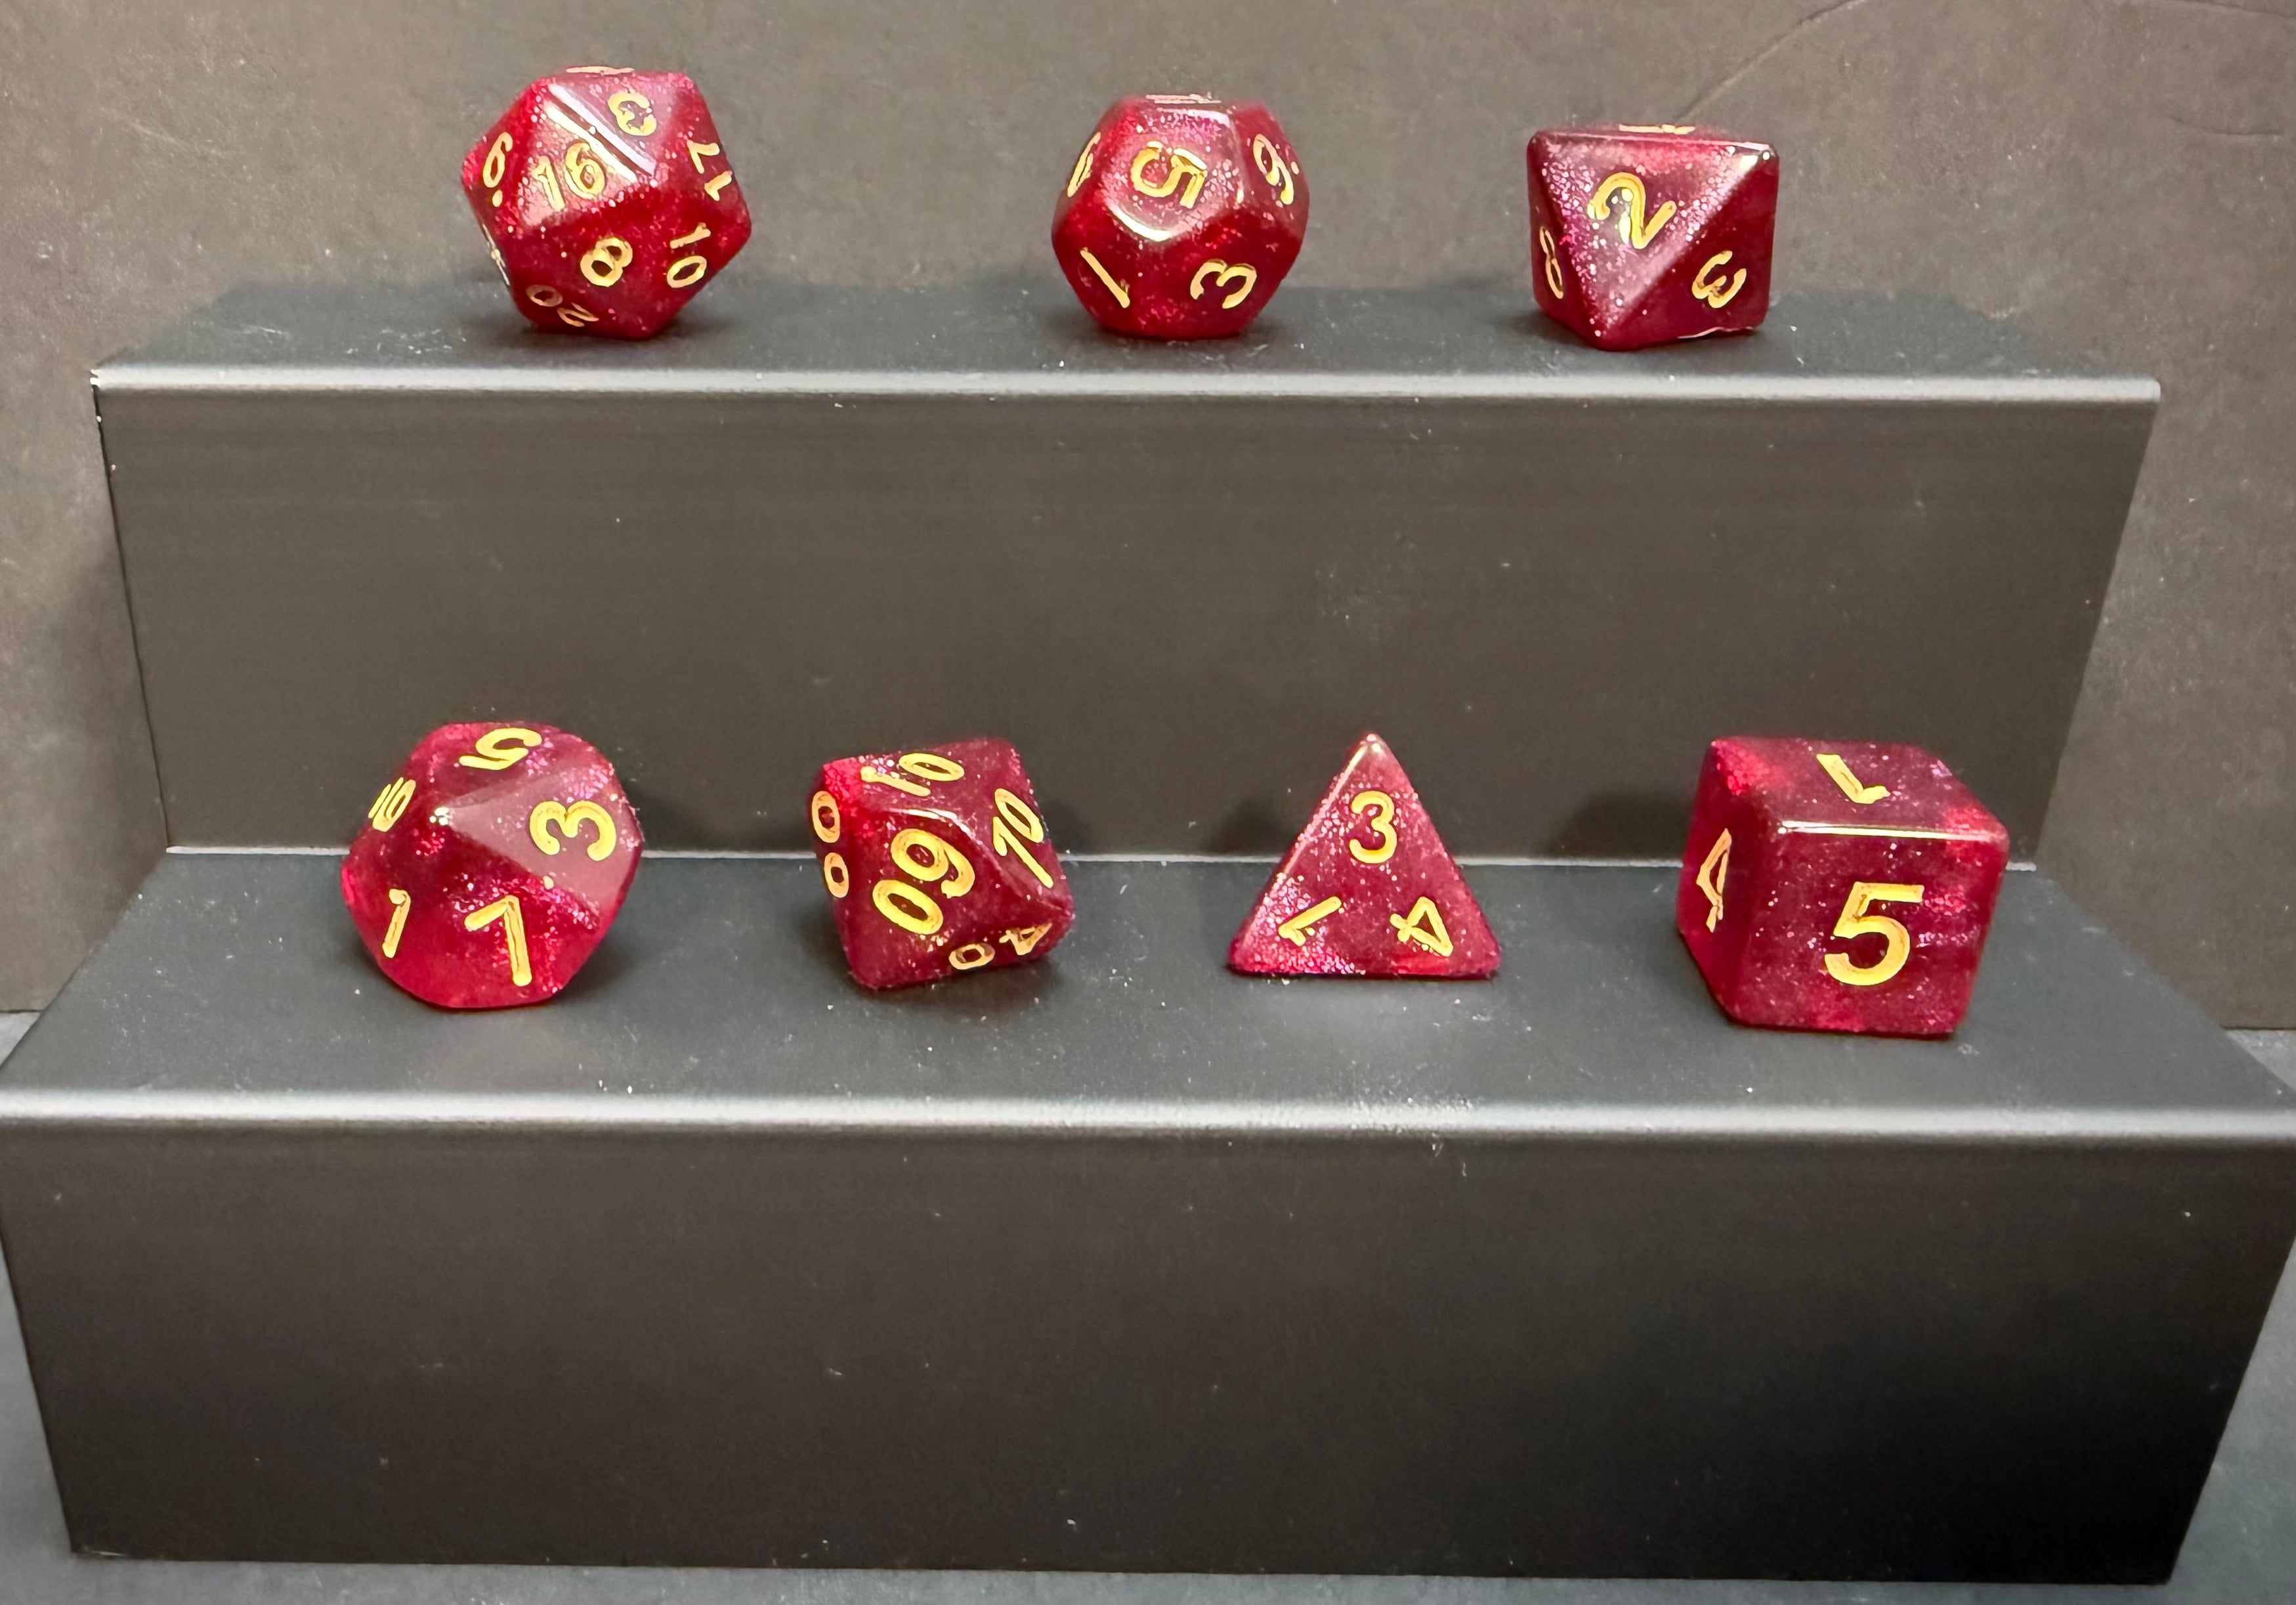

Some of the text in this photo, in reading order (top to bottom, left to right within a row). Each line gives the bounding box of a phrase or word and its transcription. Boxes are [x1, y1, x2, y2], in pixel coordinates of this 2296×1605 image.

[607, 93, 657, 137] 3
[533, 140, 606, 211] 16
[686, 140, 734, 201] 17
[1130, 140, 1208, 209] 5
[1586, 171, 1678, 249] 2
[580, 236, 633, 288] 8
[666, 223, 712, 289] 10
[1079, 247, 1131, 309] 1
[1189, 259, 1258, 310] 3
[1539, 226, 1564, 300] 8
[1691, 250, 1747, 309] 3
[526, 284, 600, 328] 20
[459, 727, 543, 771] 5
[859, 752, 966, 797] 10
[1816, 754, 1891, 805] 1
[529, 800, 617, 862] 3
[811, 790, 849, 898] 00
[1349, 790, 1398, 865] 3
[1695, 828, 1732, 933] 4
[382, 888, 412, 958] 1
[463, 895, 533, 987] 7
[1278, 896, 1343, 947] 1
[1389, 897, 1455, 958] 4
[1823, 881, 1925, 986] 5
